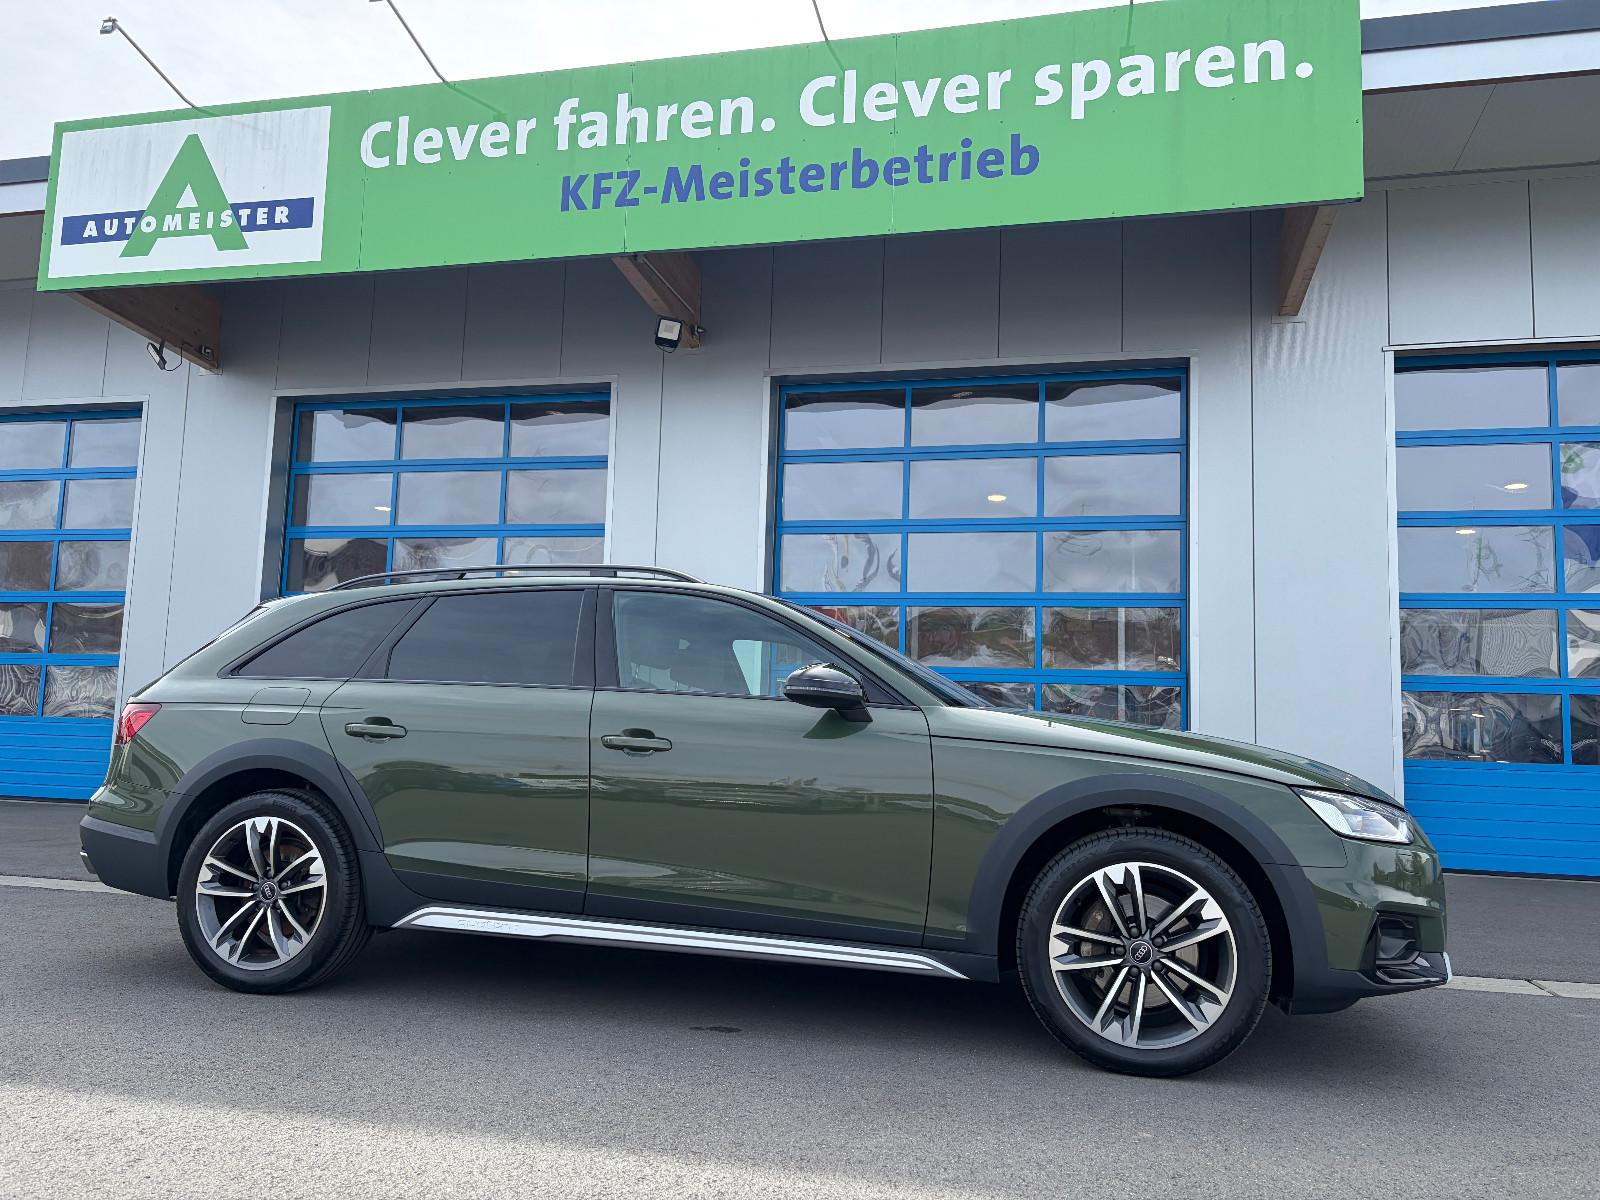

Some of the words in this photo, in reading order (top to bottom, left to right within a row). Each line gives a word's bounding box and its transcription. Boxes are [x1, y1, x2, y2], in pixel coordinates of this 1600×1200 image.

[360, 116, 537, 169] Clever
[553, 92, 776, 151] fahren.
[800, 68, 1012, 127] Clever
[1033, 39, 1314, 120] sparen.
[82, 206, 290, 238] AUTOMEISTER
[118, 131, 250, 258] A
[560, 134, 1040, 212] KFZ-Meisterbetrieb
